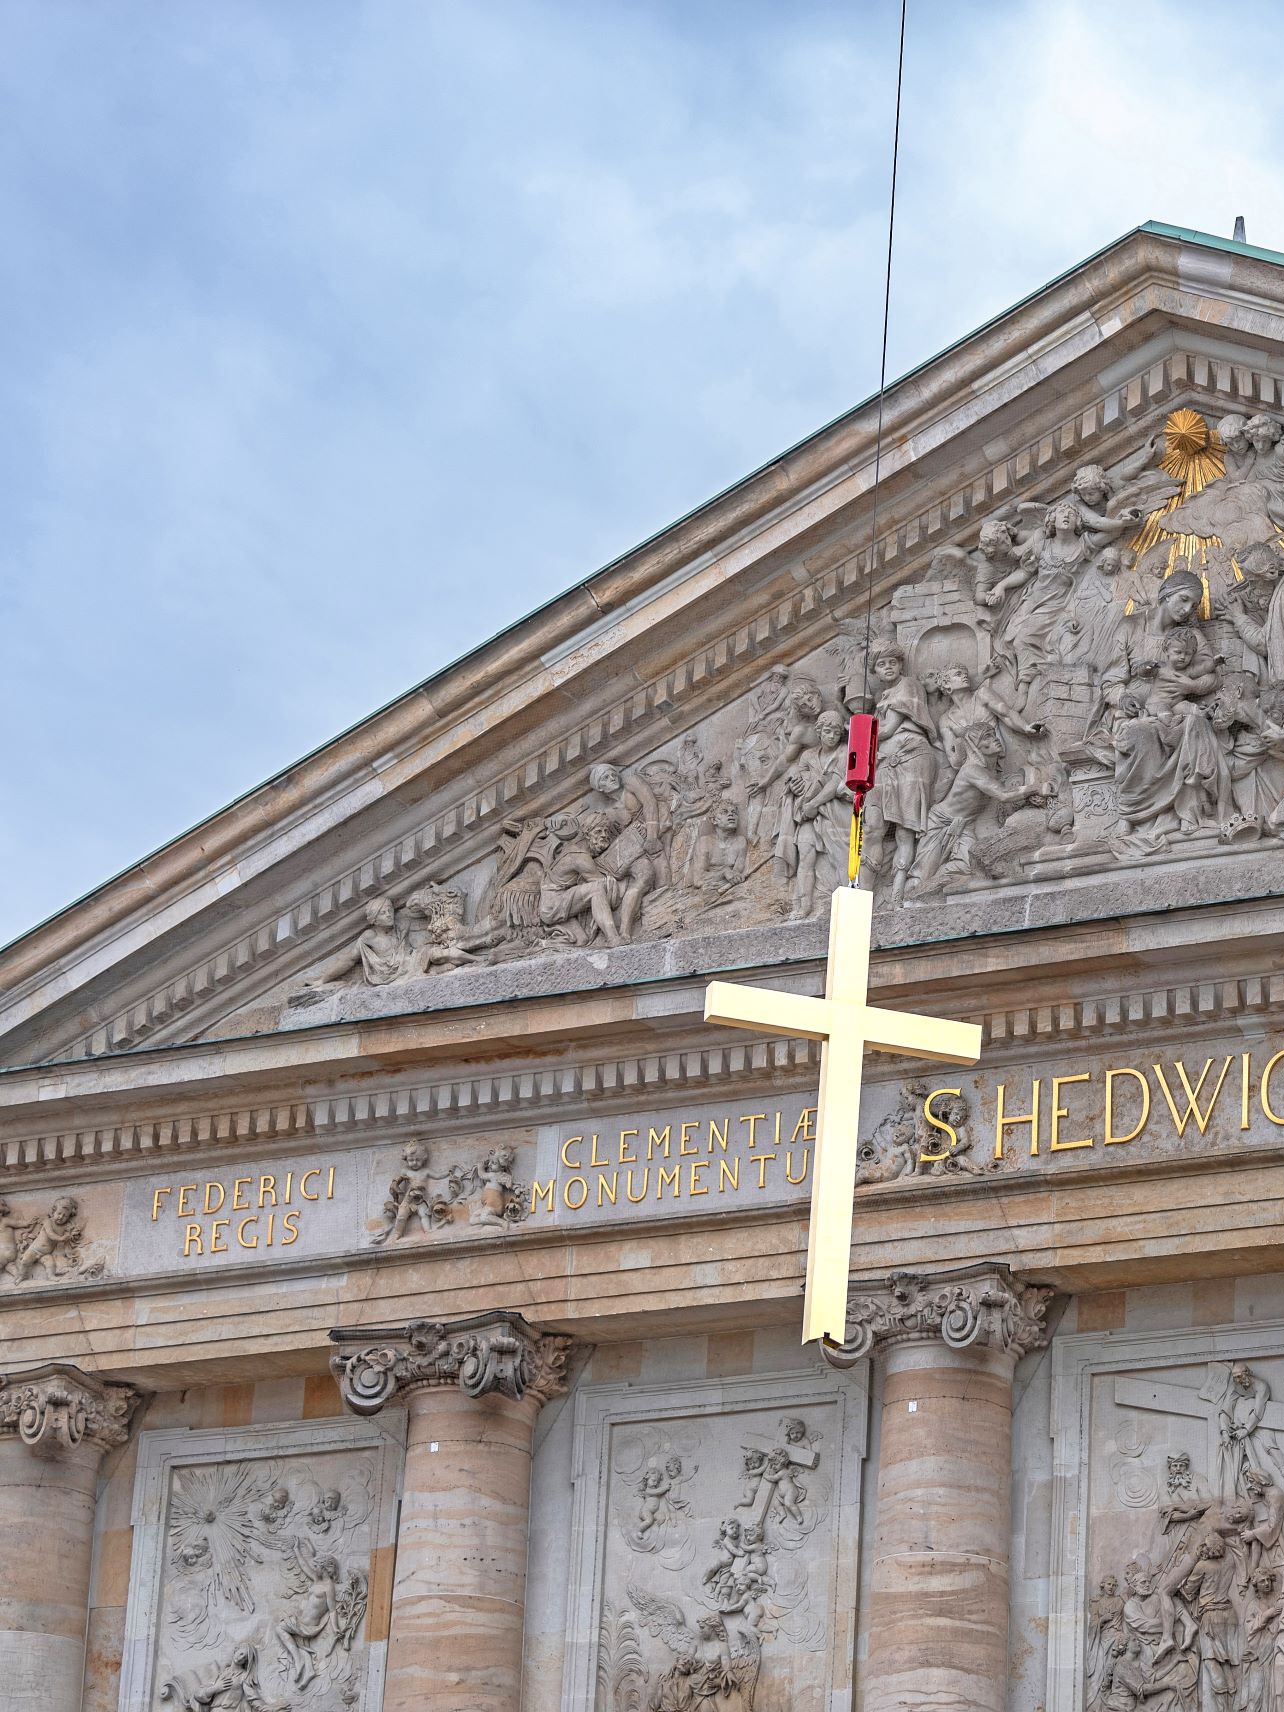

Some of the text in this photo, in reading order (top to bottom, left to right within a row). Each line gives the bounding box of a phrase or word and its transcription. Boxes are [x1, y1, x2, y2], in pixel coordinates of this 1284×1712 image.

[560, 1107, 818, 1169] CLEMENTIÆ
[920, 1087, 962, 1162] S
[151, 1166, 336, 1221] FEDERICI
[530, 1149, 810, 1214] MONUMENTU
[183, 1210, 301, 1256] REGIS
